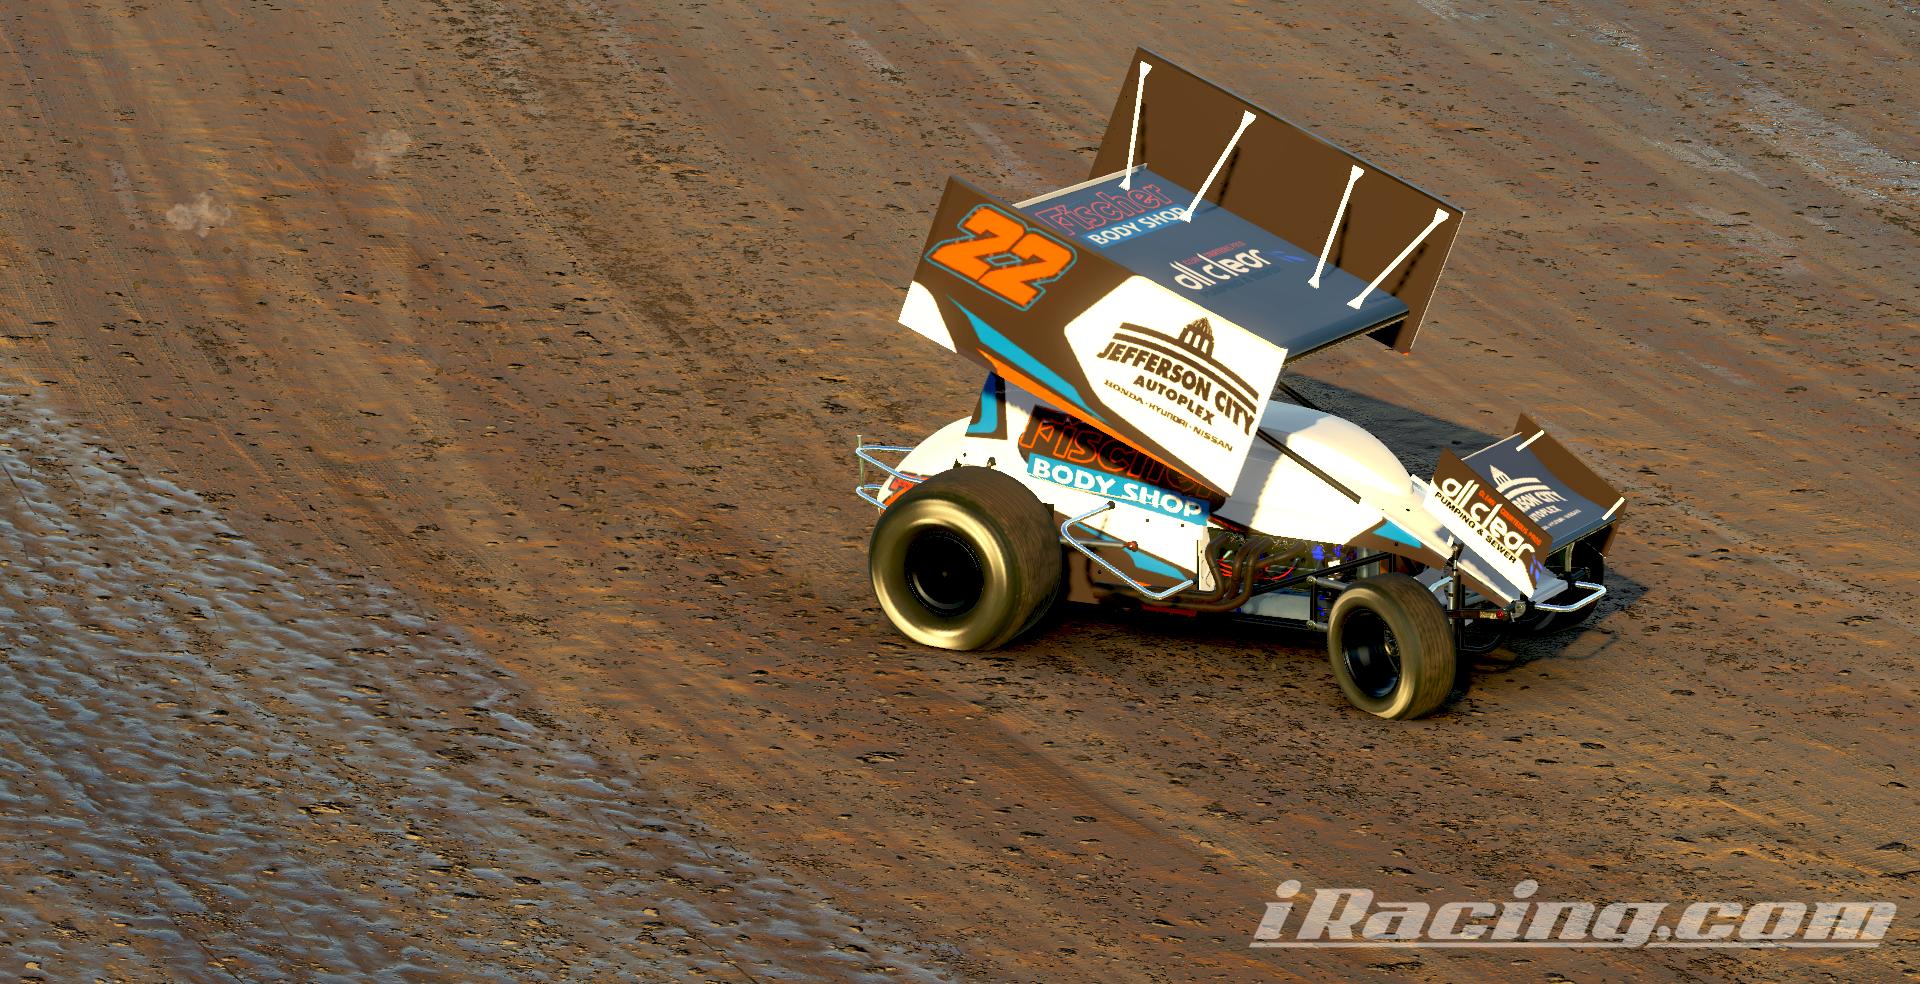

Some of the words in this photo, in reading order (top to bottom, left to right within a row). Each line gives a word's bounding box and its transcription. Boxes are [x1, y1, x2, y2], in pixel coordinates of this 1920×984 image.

[1035, 184, 1174, 236] Fischer
[1087, 221, 1142, 245] BODY
[1142, 207, 1186, 229] SHOP
[924, 204, 1078, 311] 22
[1169, 260, 1217, 290] all
[1197, 249, 1272, 281] clear
[1097, 342, 1211, 402] JEFFERSON
[1214, 390, 1255, 436] CITY
[1104, 379, 1144, 405] HONDA
[1148, 403, 1188, 428] HYUNDAI
[1193, 426, 1233, 452] NISSAN
[1133, 375, 1215, 426] AUTOPLEX
[1033, 457, 1117, 494] BODY
[1121, 481, 1203, 517] SHOP
[1511, 492, 1544, 513] RSON
[1534, 490, 1569, 503] CITY
[1528, 505, 1564, 522] UTOPLEX
[1434, 491, 1476, 529] PUMPING
[1476, 529, 1484, 537] &
[1485, 536, 1518, 564] SEWER
[1441, 477, 1479, 509] all
[1470, 503, 1536, 558] clear
